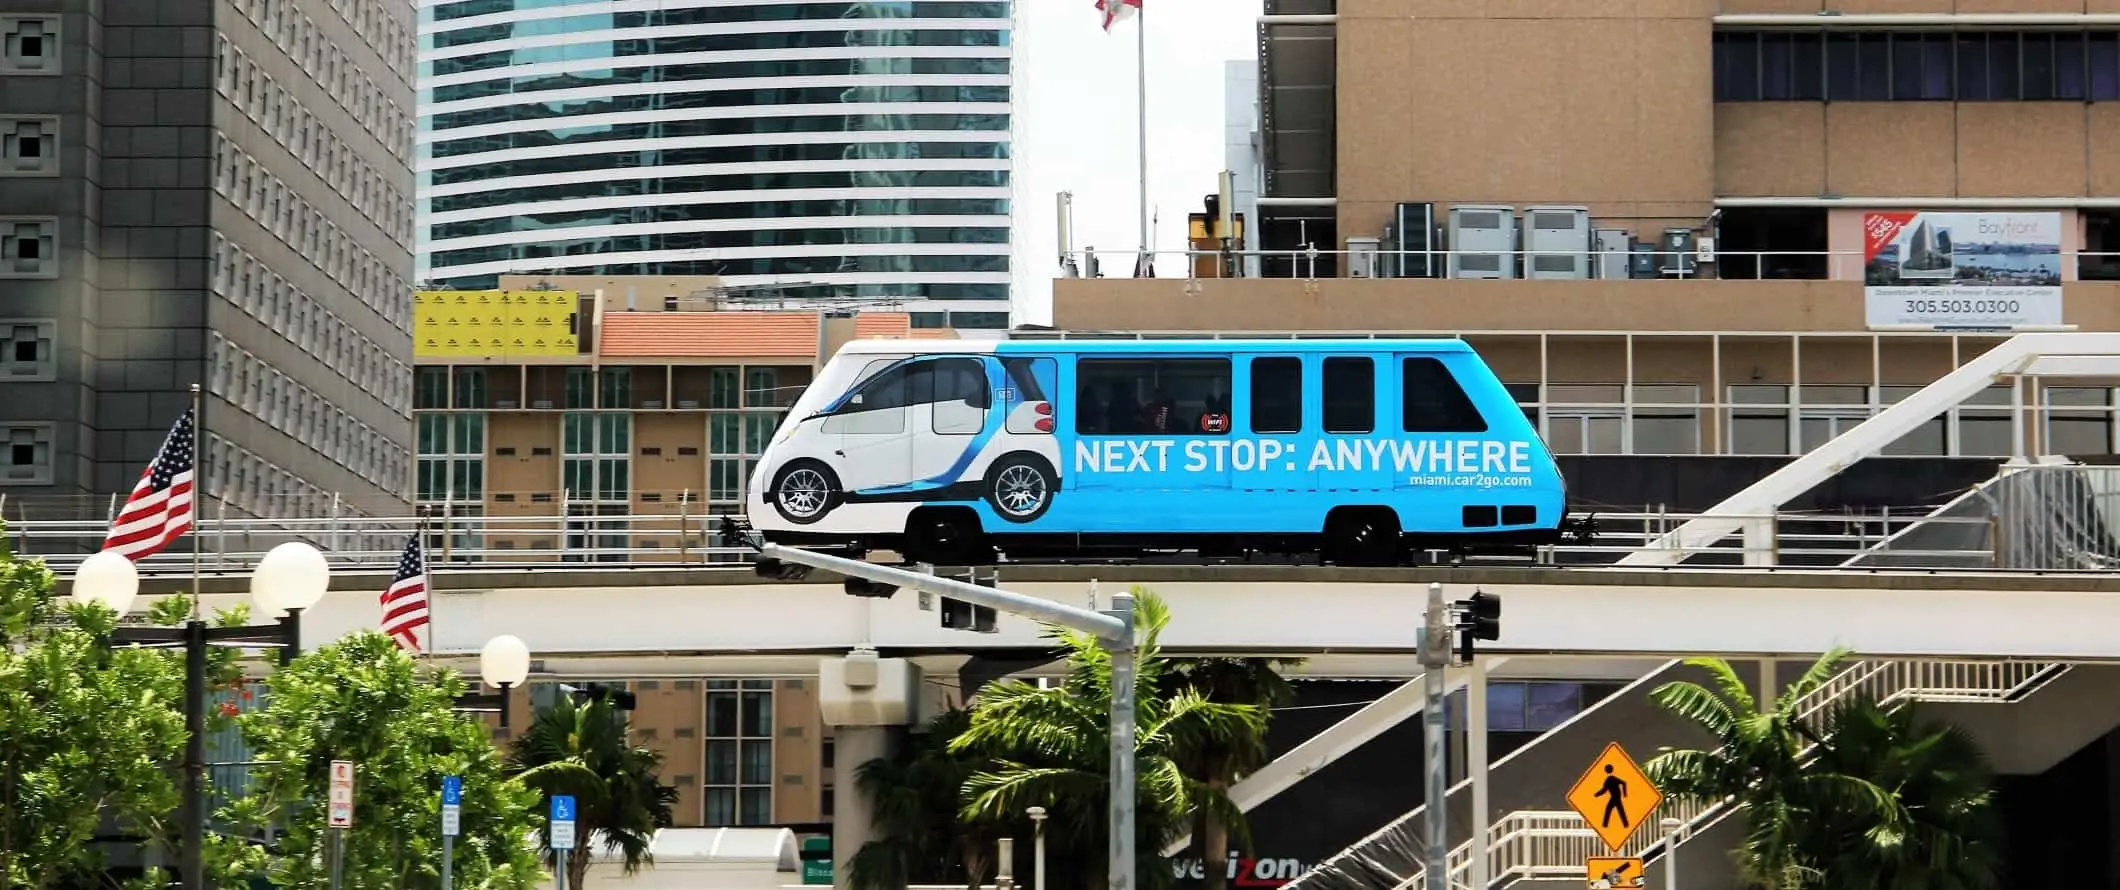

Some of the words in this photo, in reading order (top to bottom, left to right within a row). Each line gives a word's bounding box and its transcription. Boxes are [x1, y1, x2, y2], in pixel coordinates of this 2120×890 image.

[1978, 217, 2038, 238] Bayfront
[1905, 300, 2020, 313] 305.503.0300
[1075, 440, 1175, 472] NEXT
[1184, 439, 1296, 472] STOP:
[1307, 439, 1531, 473] ANYWHERE
[1409, 473, 1532, 489] miami.car2go.com
